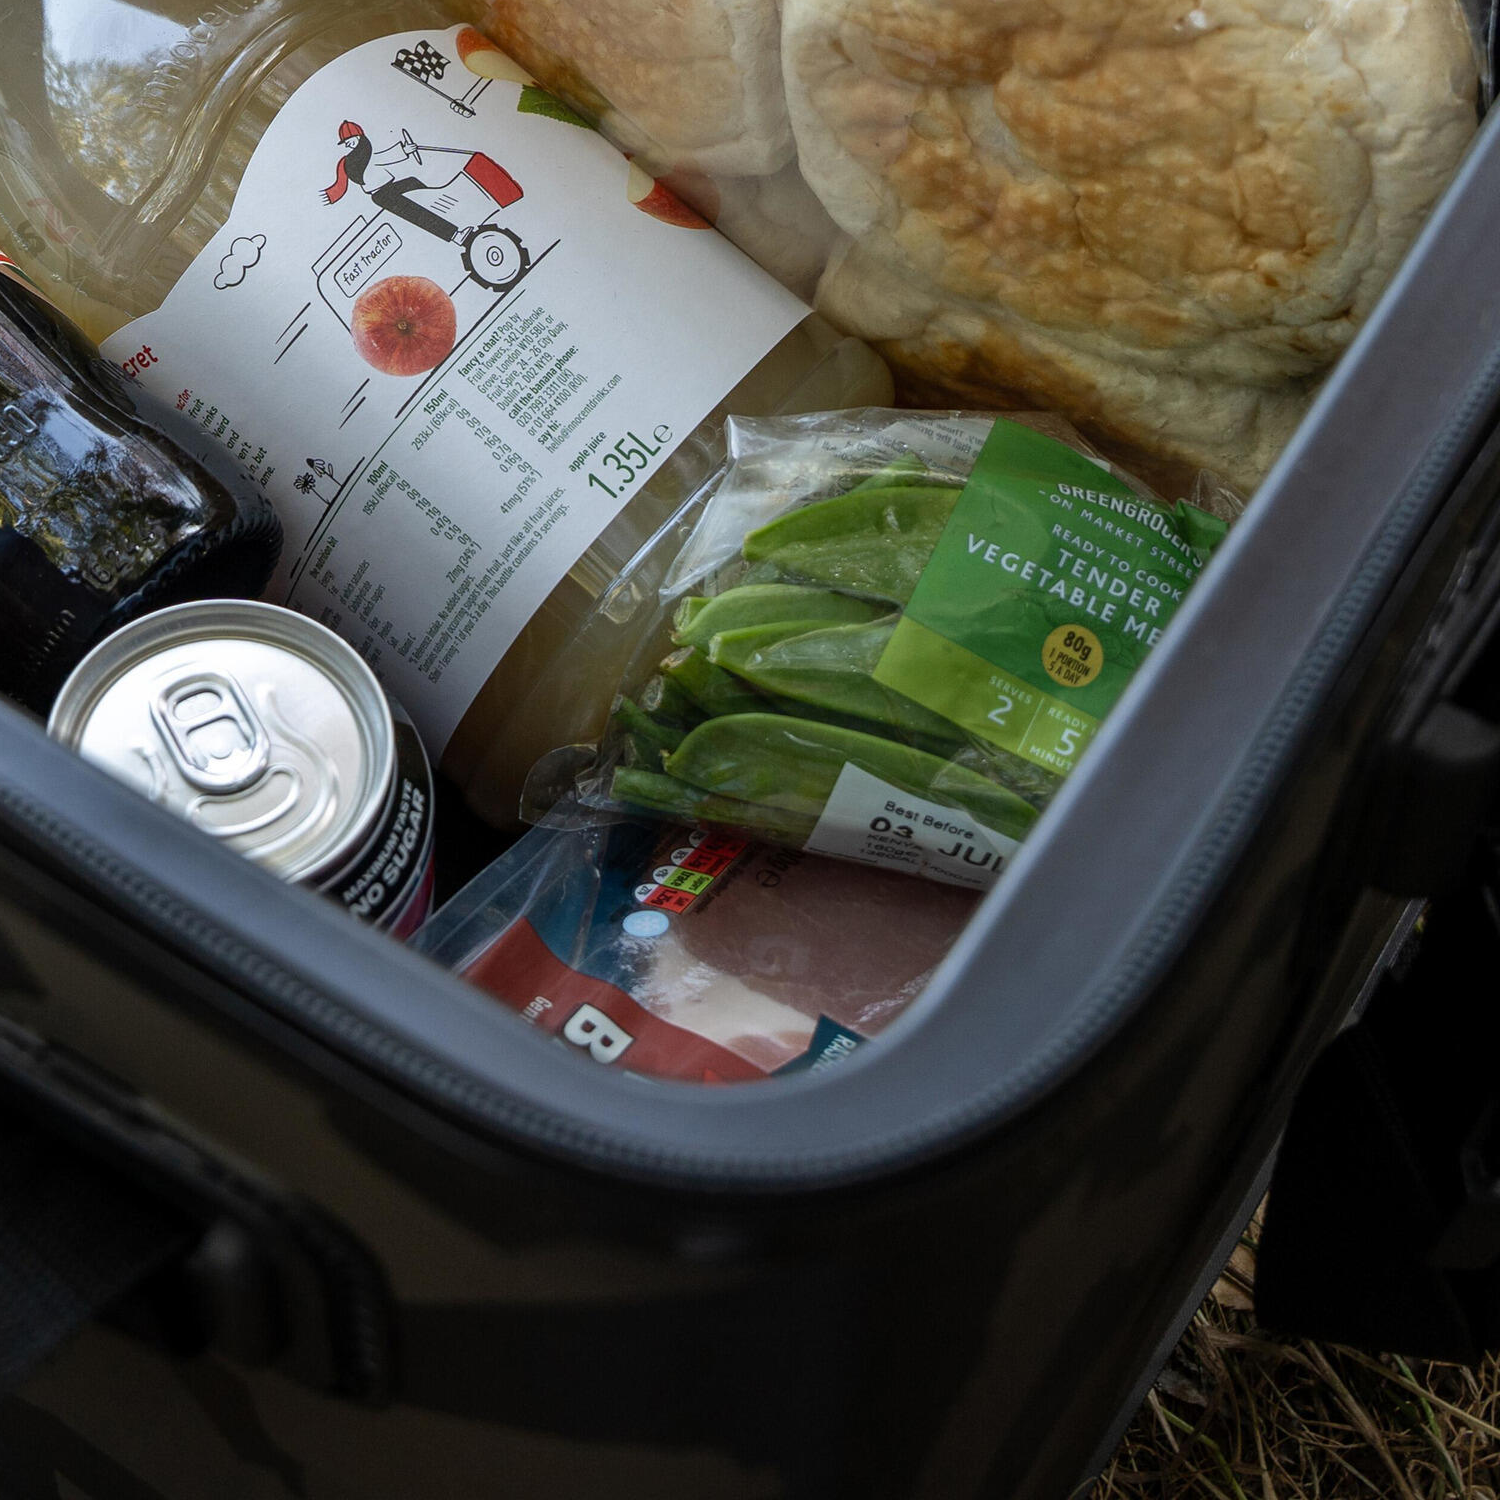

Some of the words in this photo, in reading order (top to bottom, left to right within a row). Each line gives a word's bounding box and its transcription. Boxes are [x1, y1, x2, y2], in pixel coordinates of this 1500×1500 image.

[342, 261, 363, 286] fast
[360, 233, 392, 267] tractor
[120, 344, 159, 382] cret
[456, 354, 482, 378] fancy
[475, 348, 486, 360] a
[481, 330, 503, 354] chat?
[496, 320, 514, 336] Pop
[507, 311, 522, 324] by
[466, 366, 487, 386] Fruit
[480, 344, 510, 371] Towers,
[503, 330, 520, 348] 342
[514, 305, 546, 336] Ladbroke
[476, 371, 502, 395] Grove,
[495, 347, 523, 374] London
[516, 333, 535, 351] W10
[544, 314, 555, 325] or
[486, 384, 506, 403] Fruit
[500, 368, 524, 390] Spire,
[516, 358, 530, 371] 24
[528, 344, 542, 358] 26
[537, 334, 554, 350] City
[547, 320, 569, 339] Quay,
[496, 386, 521, 412] Dublin
[515, 380, 529, 392] 2,
[533, 350, 556, 371] NY19.
[507, 402, 524, 420] call
[518, 391, 534, 407] the
[528, 366, 558, 395] banana
[553, 344, 580, 372] phone:
[515, 410, 533, 428] 020
[527, 394, 548, 415] 7993
[542, 380, 561, 400] 3311
[556, 367, 575, 387] (UK)
[552, 388, 572, 407] 4100
[365, 459, 389, 486] 100ml
[422, 388, 449, 416] 150ml
[527, 425, 538, 437] or
[532, 416, 546, 429] 01
[536, 429, 554, 446] say
[546, 419, 562, 433] hi:
[540, 403, 558, 421] 664
[545, 372, 623, 455] hello@innocentdrinks.com
[361, 494, 381, 516] 195kJ
[373, 468, 401, 501] (46kcal)
[410, 424, 435, 451] 293kJ
[429, 396, 461, 430] (69kcal)
[567, 448, 591, 473] apple
[584, 430, 608, 454] juice
[586, 428, 662, 501] 1.35L
[1049, 493, 1073, 511] ON
[1079, 508, 1144, 548] MARKET
[1148, 545, 1193, 579] STREE
[1051, 523, 1104, 558] READY
[1108, 553, 1131, 573] TO
[1134, 568, 1182, 601] COOK
[967, 534, 1117, 623] VEGETABLE
[1122, 614, 1164, 649] ME
[1056, 548, 1162, 617] TENDER
[1054, 665, 1063, 676] A
[1062, 668, 1081, 685] DAY
[1055, 651, 1091, 677] PORTION
[1062, 630, 1093, 662] 80g
[986, 694, 1014, 726] 2
[1053, 726, 1081, 757] 5
[988, 675, 1033, 705] SERVES
[1047, 706, 1087, 731] READY
[1029, 744, 1068, 768] MINUT
[340, 831, 395, 900] MAXIMUM
[392, 778, 413, 832] TASTE
[869, 815, 914, 840] 03
[883, 800, 919, 822] Best
[922, 814, 974, 840] Before
[348, 880, 386, 916] NO
[381, 788, 424, 885] SUGAR
[562, 1003, 633, 1064] B
[811, 1033, 857, 1072] RASH
